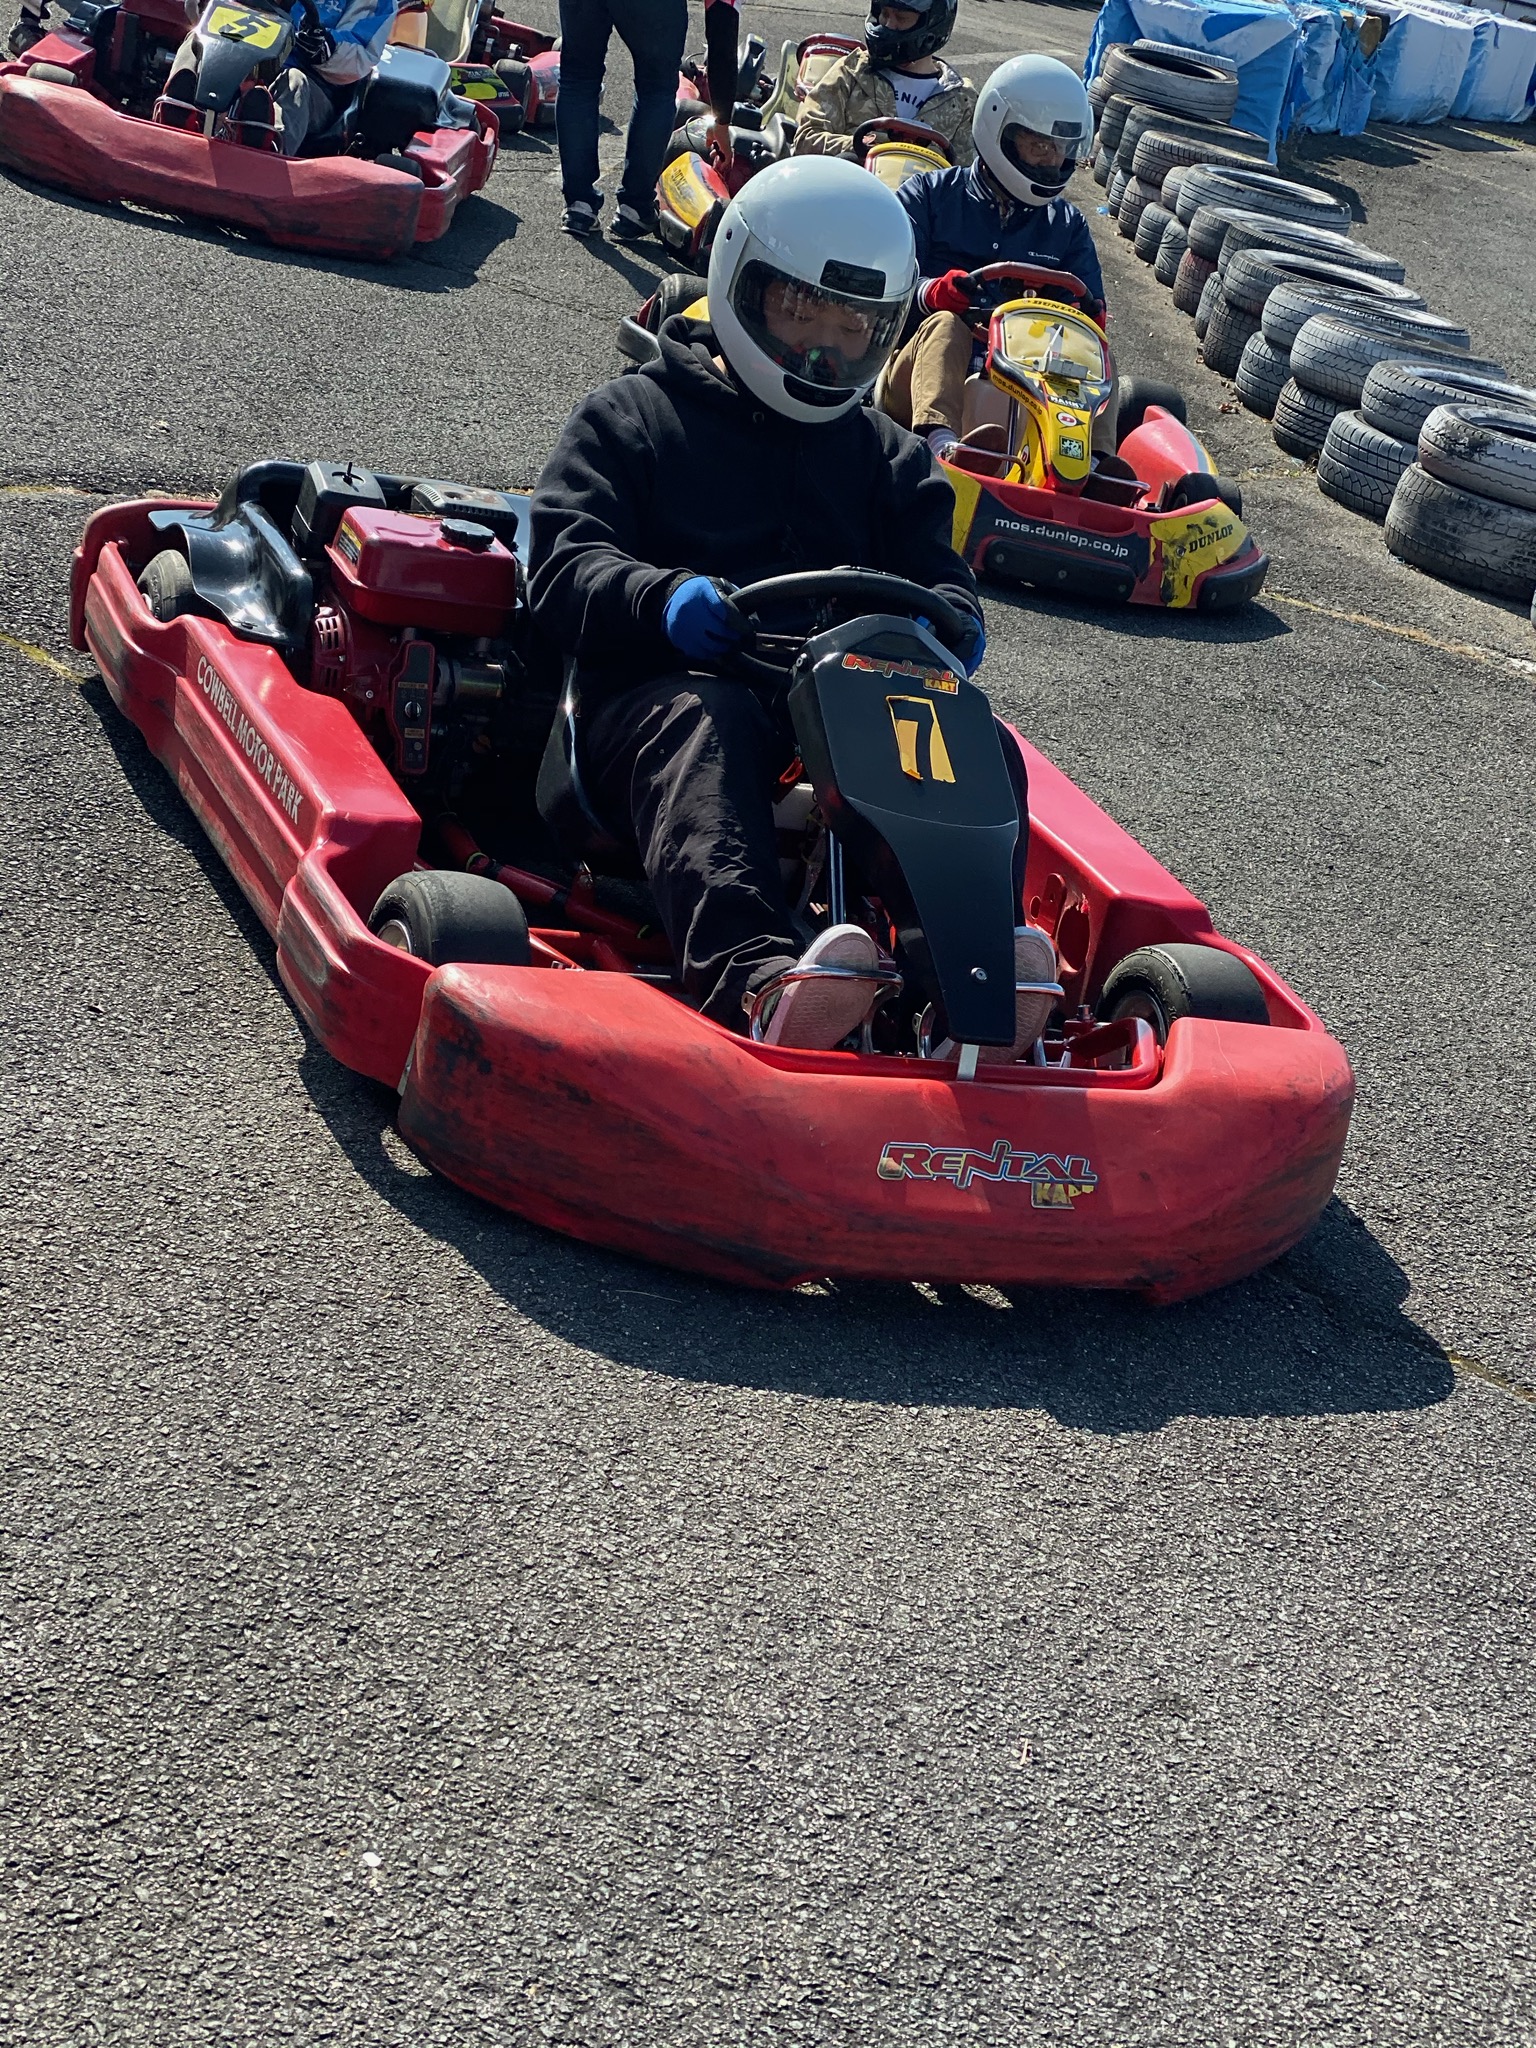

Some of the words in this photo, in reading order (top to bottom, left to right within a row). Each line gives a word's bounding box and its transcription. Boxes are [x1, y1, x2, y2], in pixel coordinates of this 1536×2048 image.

[1031, 299, 1085, 316] DUNLOP
[994, 517, 1129, 557] mos.dunlop.co.jp
[1189, 523, 1234, 554] DUNLOP
[842, 652, 955, 679] RENTAL
[924, 677, 958, 693] KART
[196, 655, 238, 734] COWBELL
[235, 713, 276, 786] MOTOR
[271, 761, 304, 825] PARK
[885, 695, 953, 783] 7
[877, 1139, 1099, 1189] RENTAL
